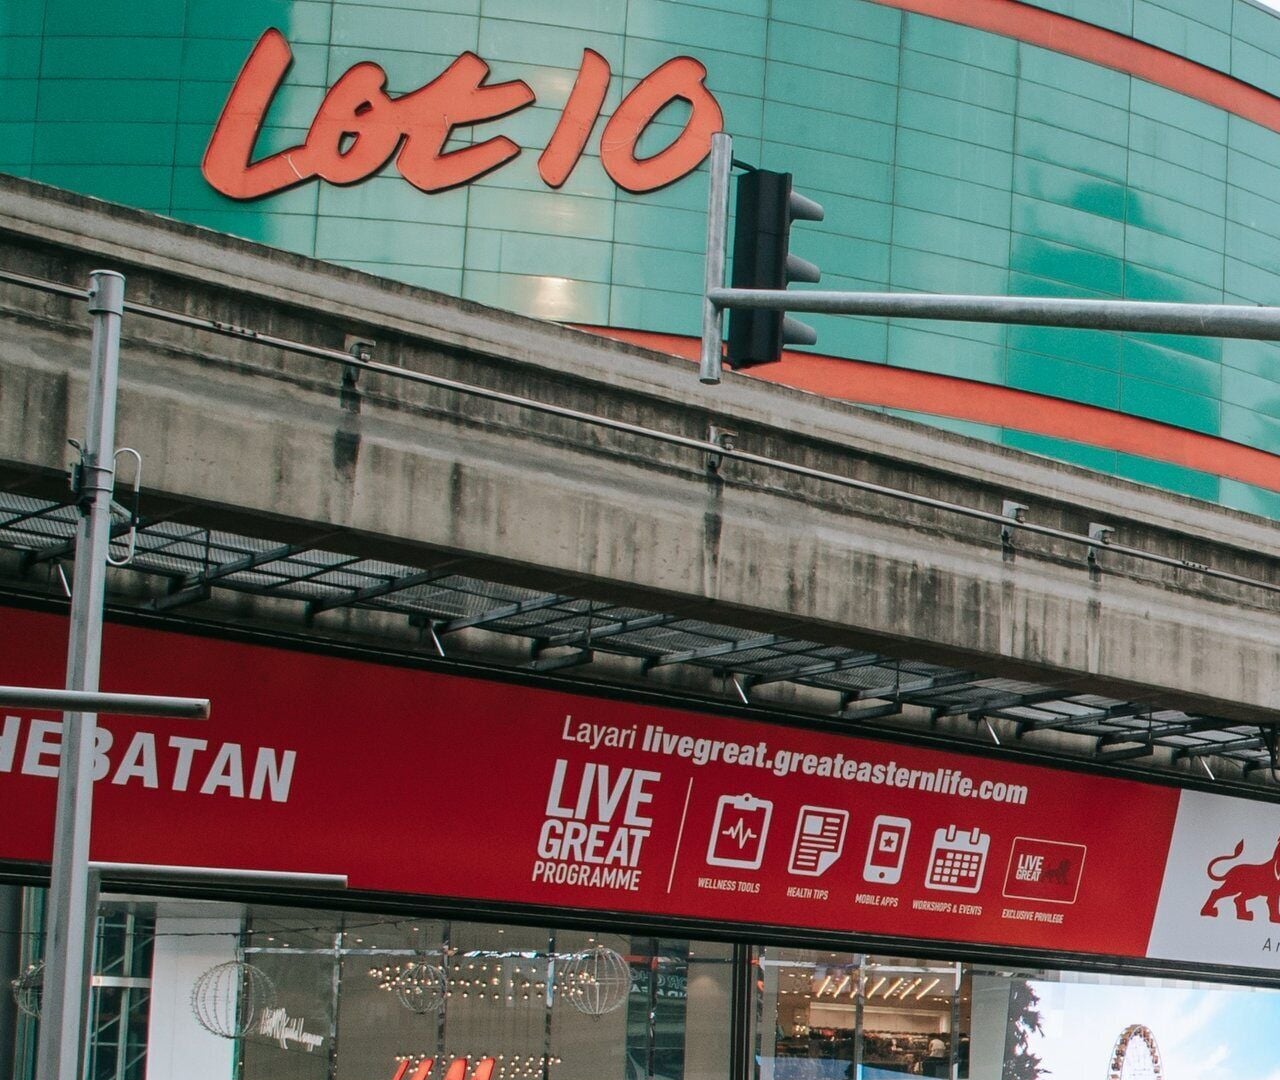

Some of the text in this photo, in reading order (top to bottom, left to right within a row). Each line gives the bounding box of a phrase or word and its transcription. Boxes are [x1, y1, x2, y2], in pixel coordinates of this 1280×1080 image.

[203, 27, 724, 200] Lot 10
[562, 714, 1029, 805] Layari livegreat.greateasternlife.com
[545, 758, 662, 828] LIVE
[537, 818, 651, 867] GREAT
[1018, 853, 1044, 870] LIVE
[531, 860, 642, 891] PROGRAMME
[1015, 869, 1042, 882] GREAT
[697, 877, 761, 894] WELLNESS TOOLS
[786, 886, 829, 900] HEALTH TIPS
[854, 893, 899, 907] MOBILE APPS
[912, 899, 951, 913] WORKSHOPS
[958, 904, 983, 916] EVENTS
[1001, 908, 1064, 924] EXCLUSIVE PRIVILEGE
[1262, 937, 1272, 951] A
